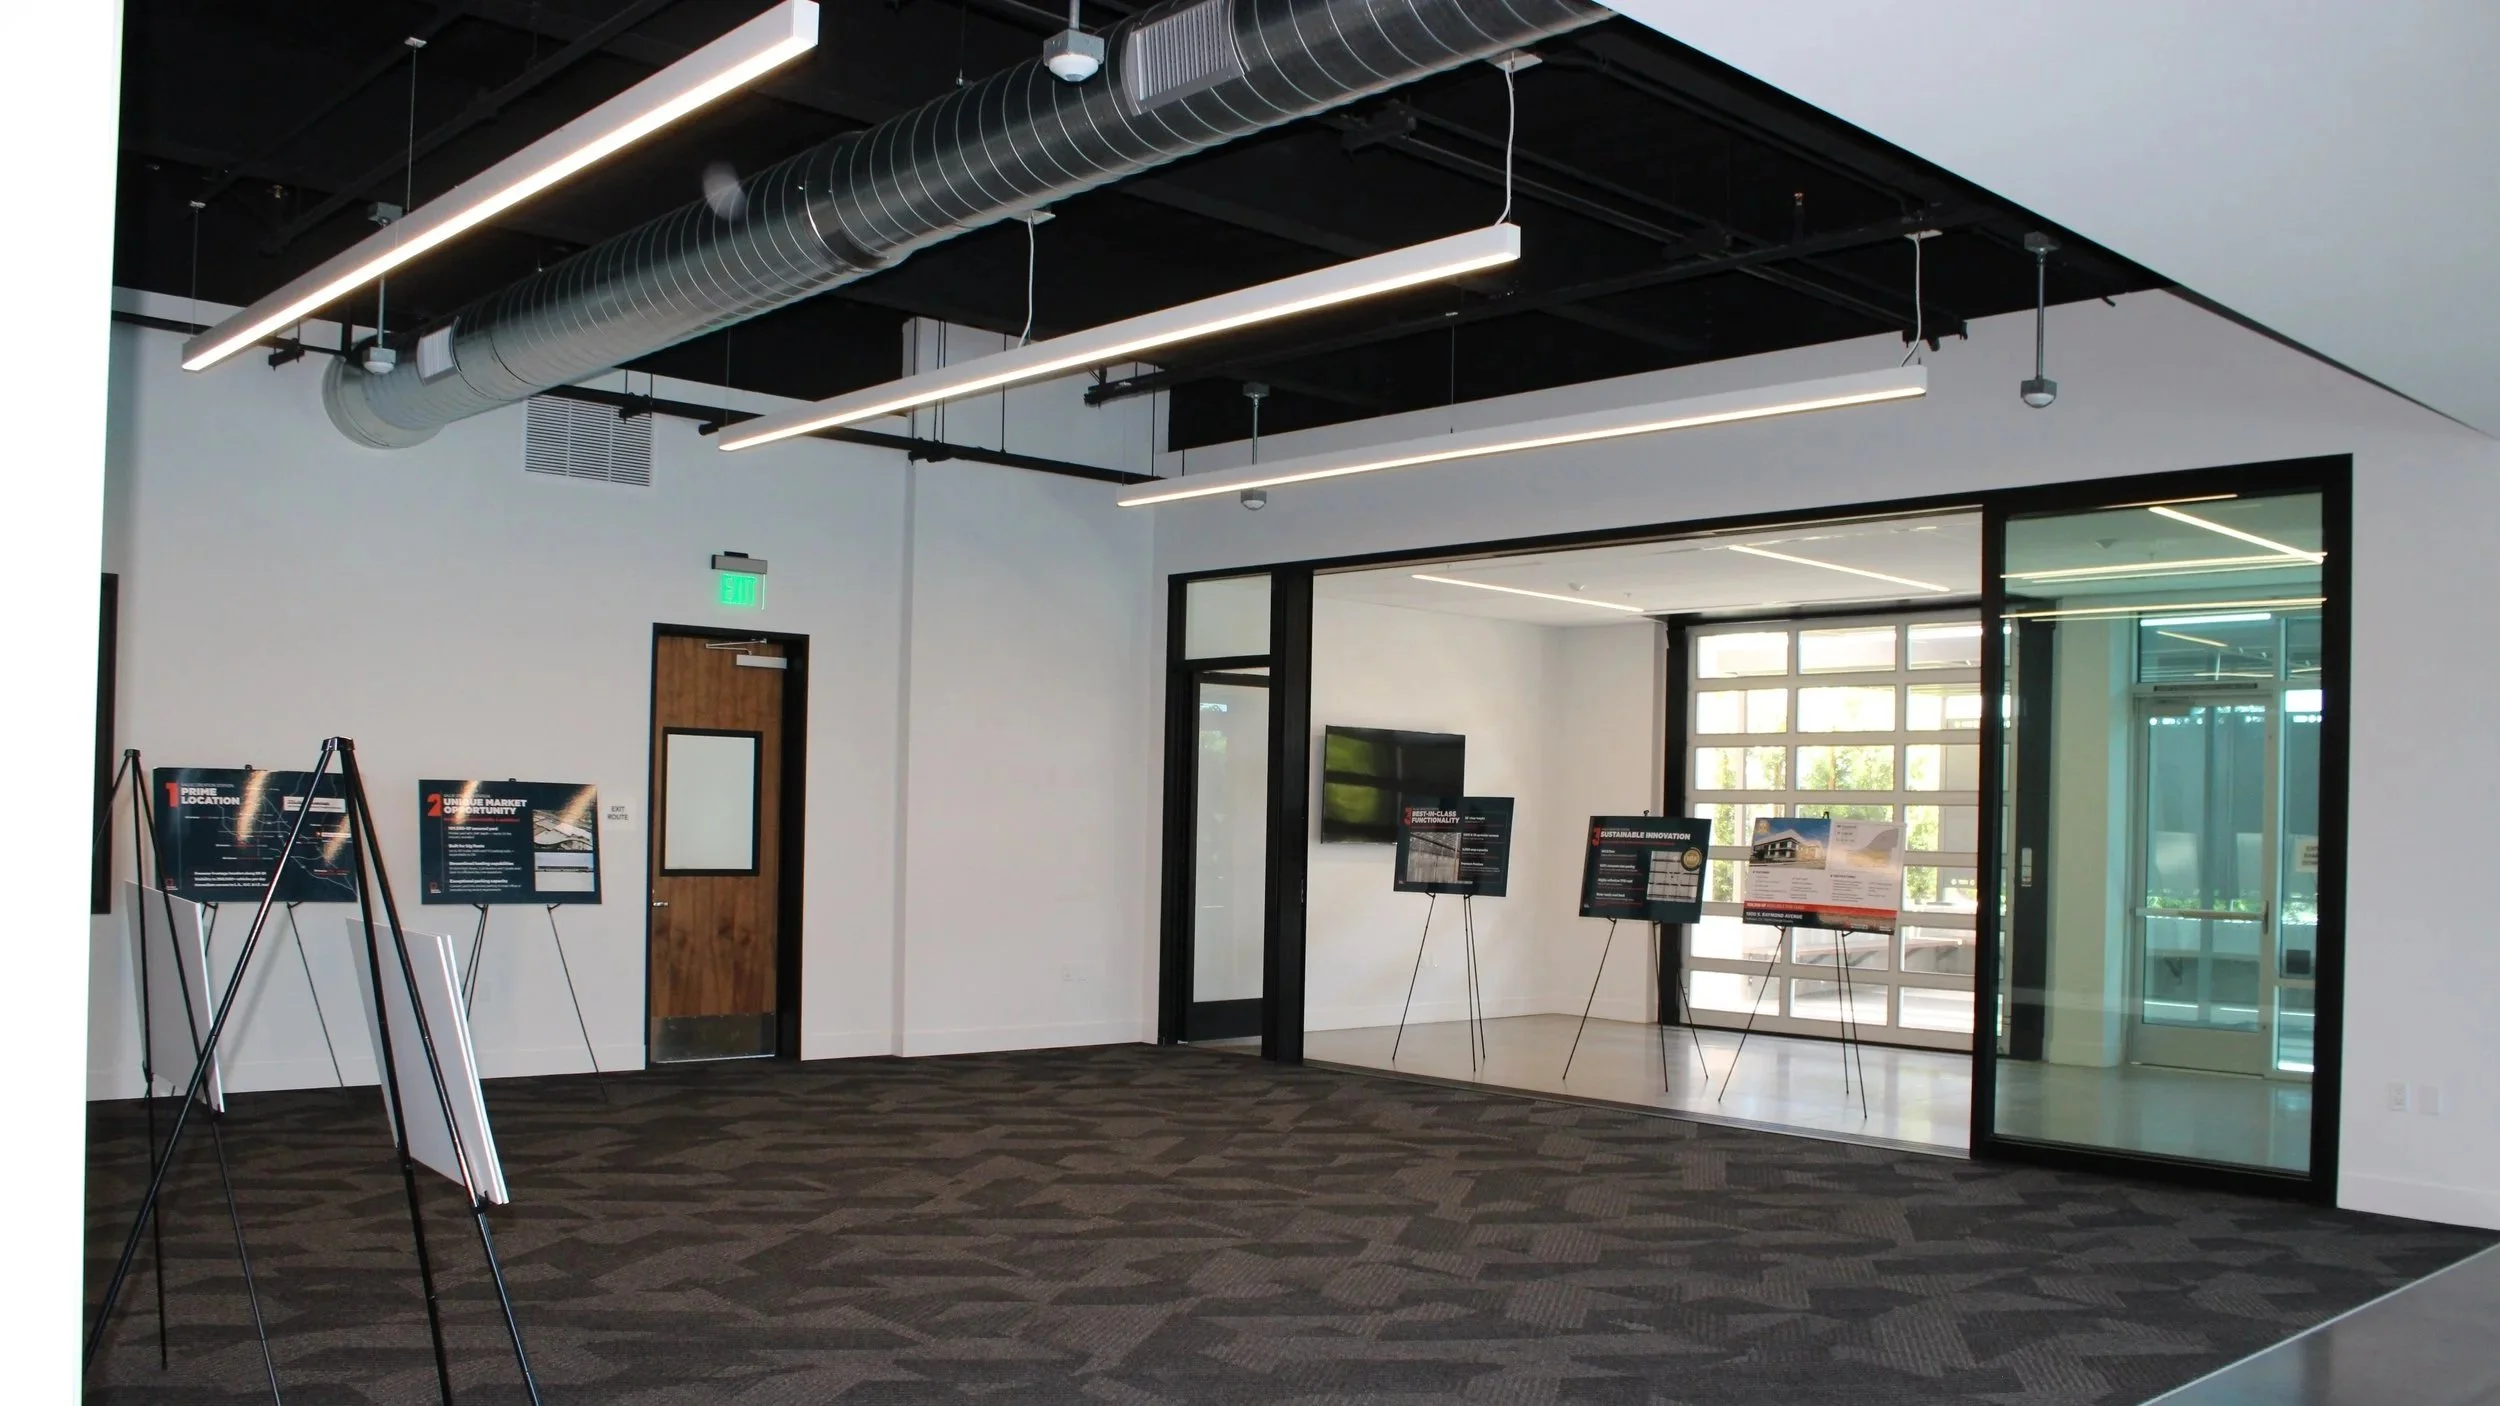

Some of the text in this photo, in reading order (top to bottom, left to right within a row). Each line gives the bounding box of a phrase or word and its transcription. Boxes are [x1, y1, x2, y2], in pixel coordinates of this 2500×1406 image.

[721, 573, 757, 606] EXIT
[165, 782, 178, 808] 1
[181, 787, 217, 796] PRIME
[181, 796, 241, 805] LOCATION
[427, 793, 441, 817] 2
[485, 799, 528, 808] MARKET
[443, 806, 517, 815] OPORTUNITY
[1600, 831, 1691, 840] SUSTAINABLE INNOVATION
